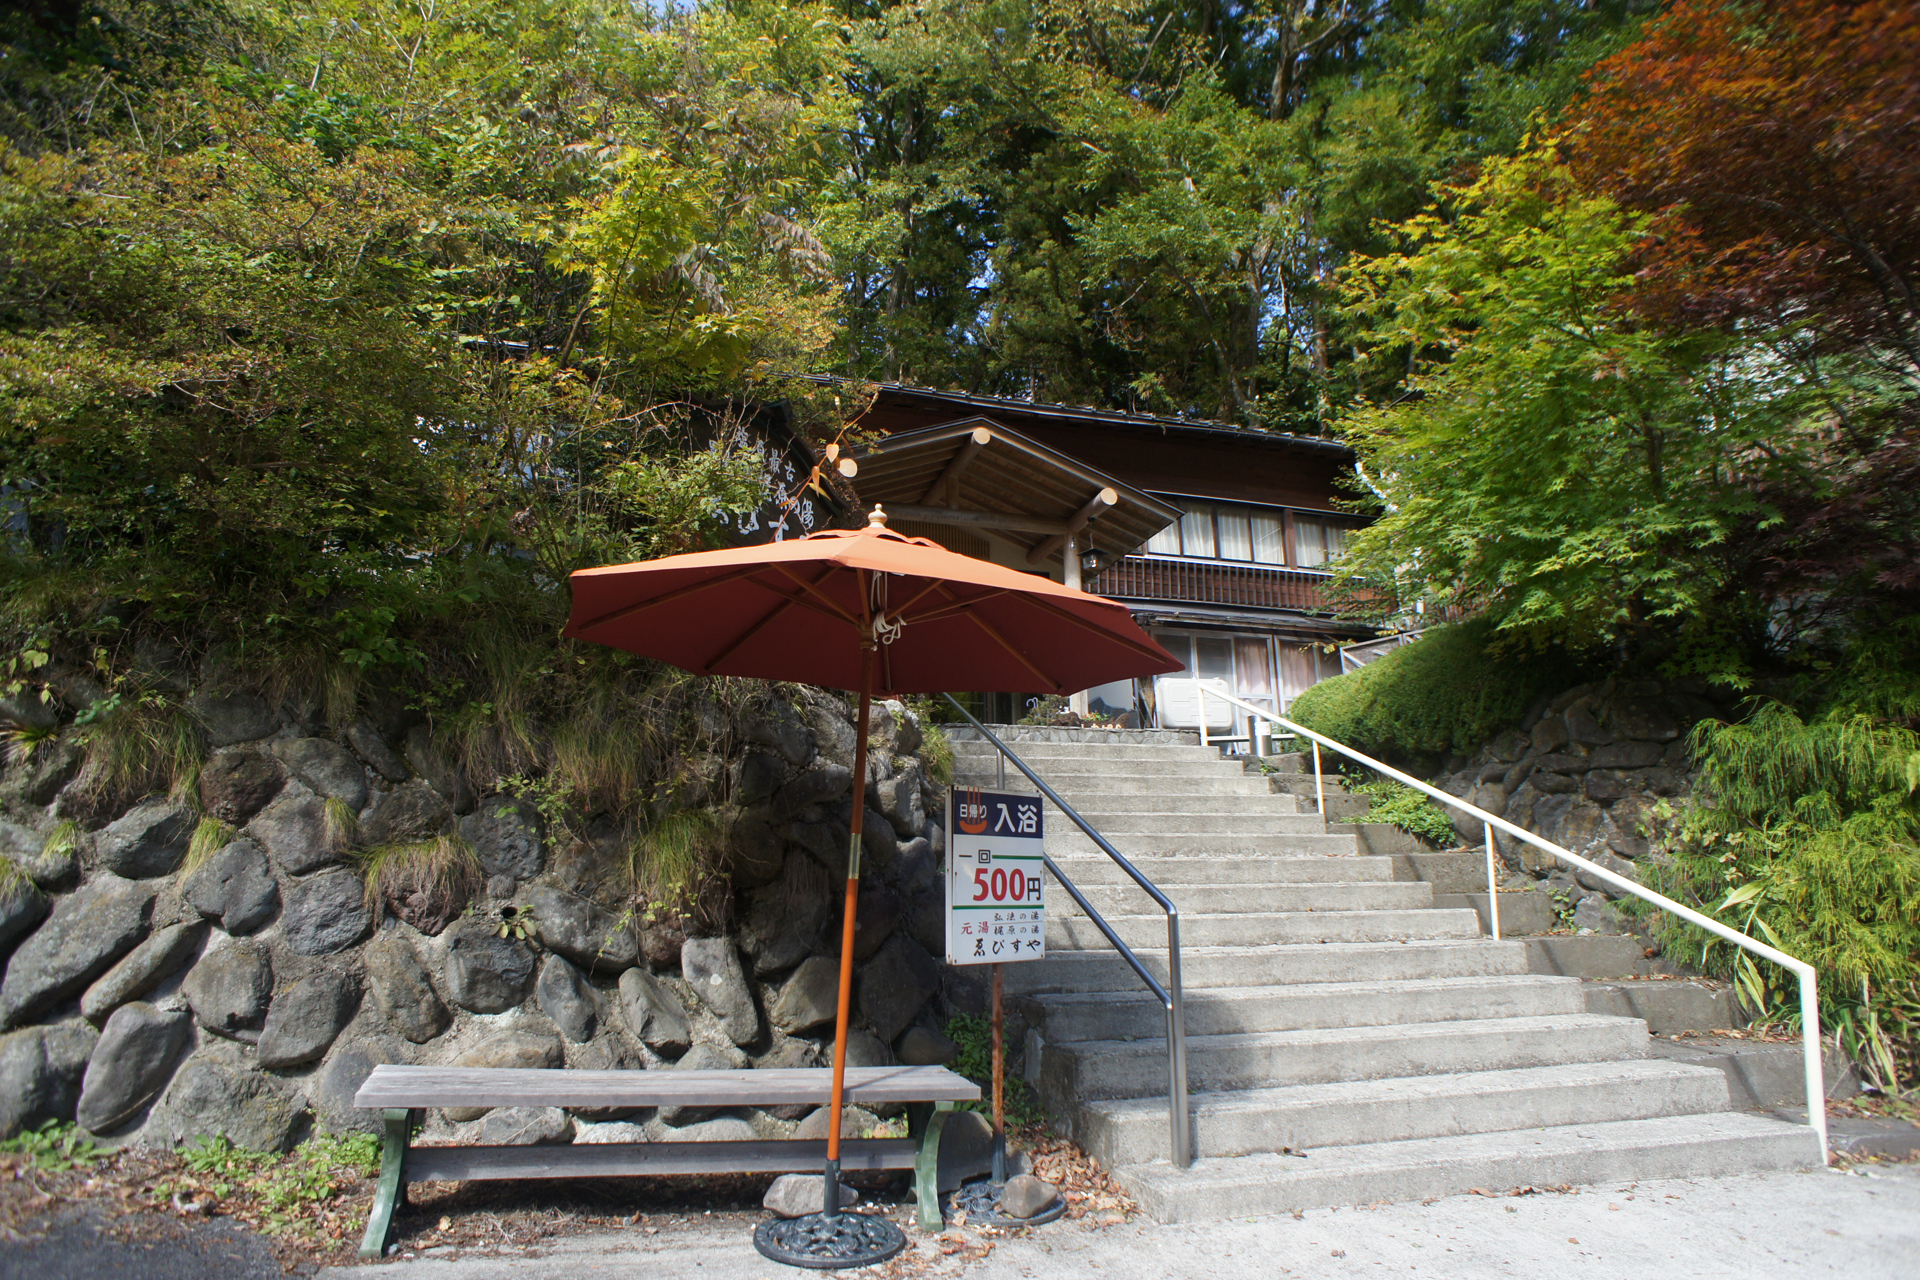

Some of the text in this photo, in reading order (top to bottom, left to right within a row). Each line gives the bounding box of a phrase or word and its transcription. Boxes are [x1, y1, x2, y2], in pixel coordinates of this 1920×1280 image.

[960, 803, 1038, 833] 日帰り 入浴
[958, 849, 991, 864] 一回
[973, 867, 1041, 902] 500円
[960, 921, 990, 935] 元湯
